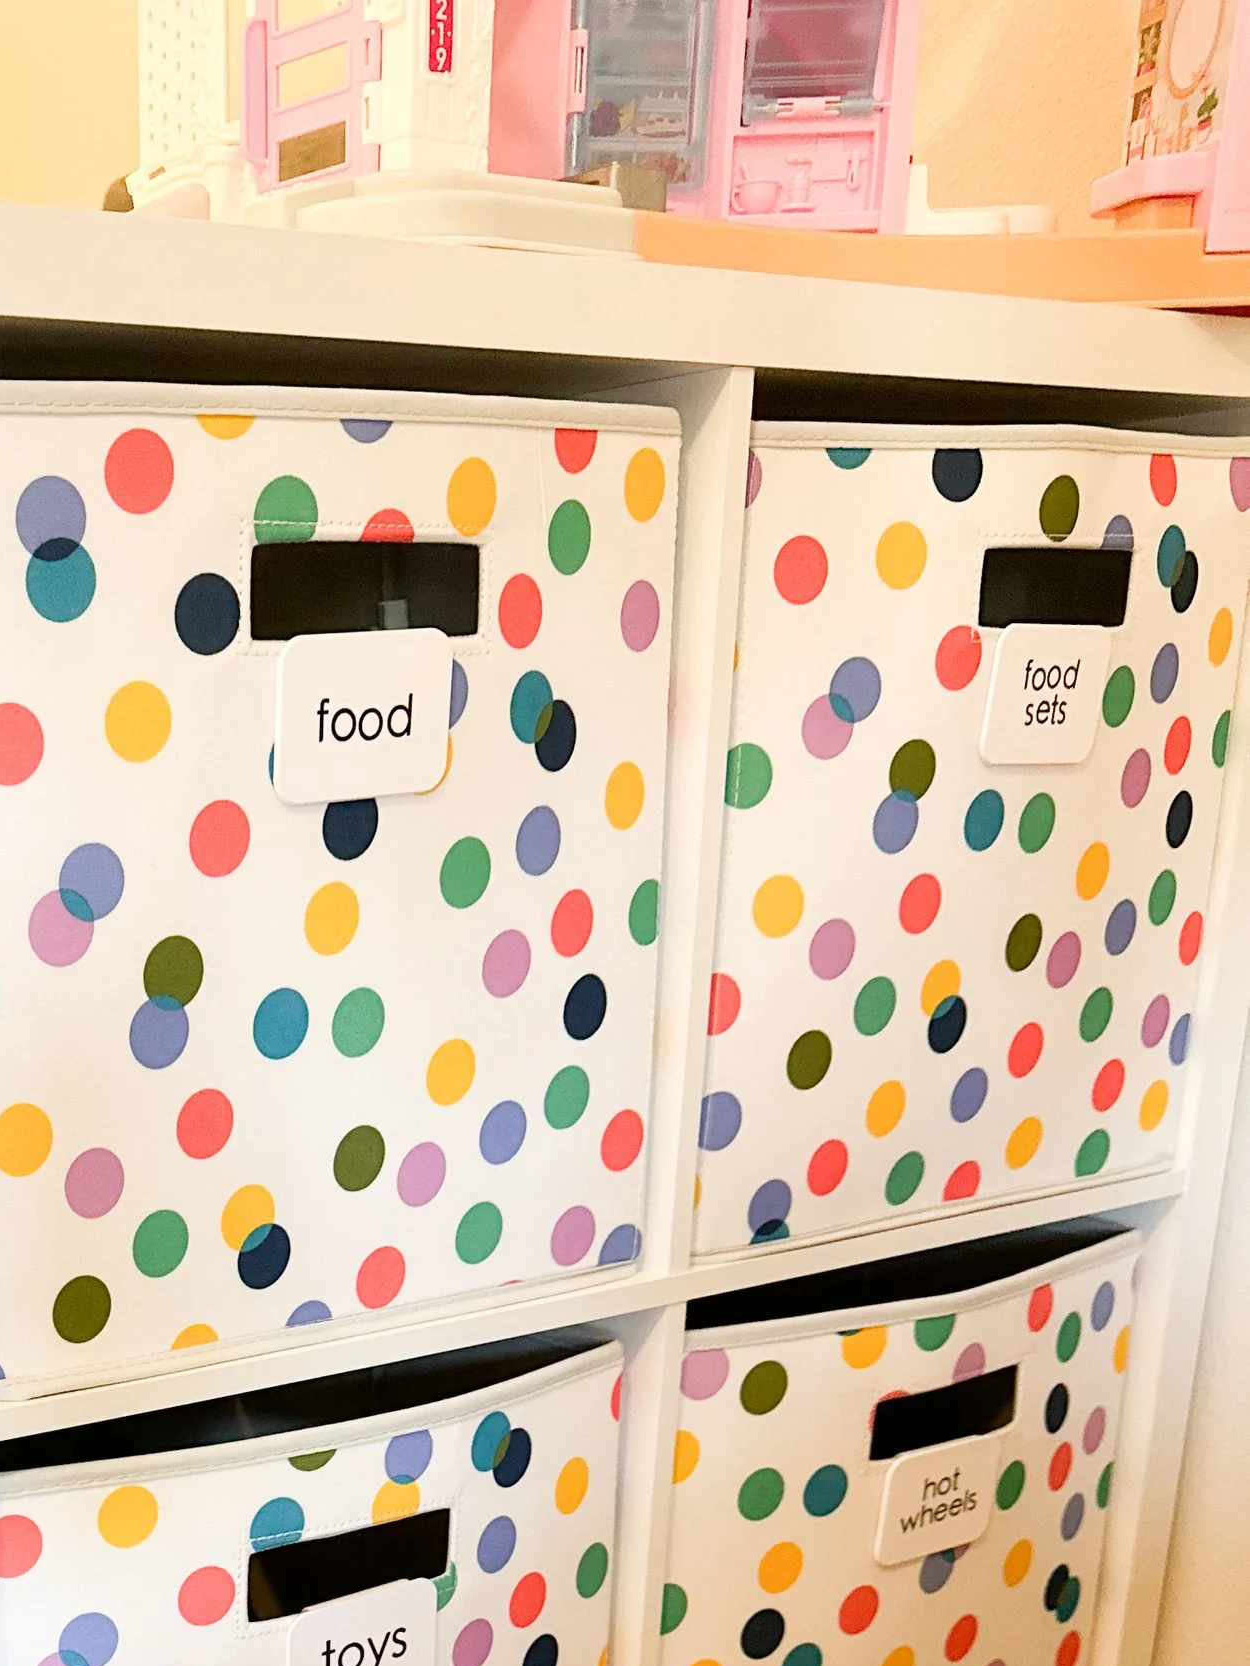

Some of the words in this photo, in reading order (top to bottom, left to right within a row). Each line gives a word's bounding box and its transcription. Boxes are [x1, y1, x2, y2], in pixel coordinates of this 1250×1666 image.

[1023, 658, 1081, 692] food
[316, 692, 414, 743] food
[1024, 693, 1068, 727] sets
[922, 1467, 961, 1501] hot
[900, 1488, 978, 1534] wheels
